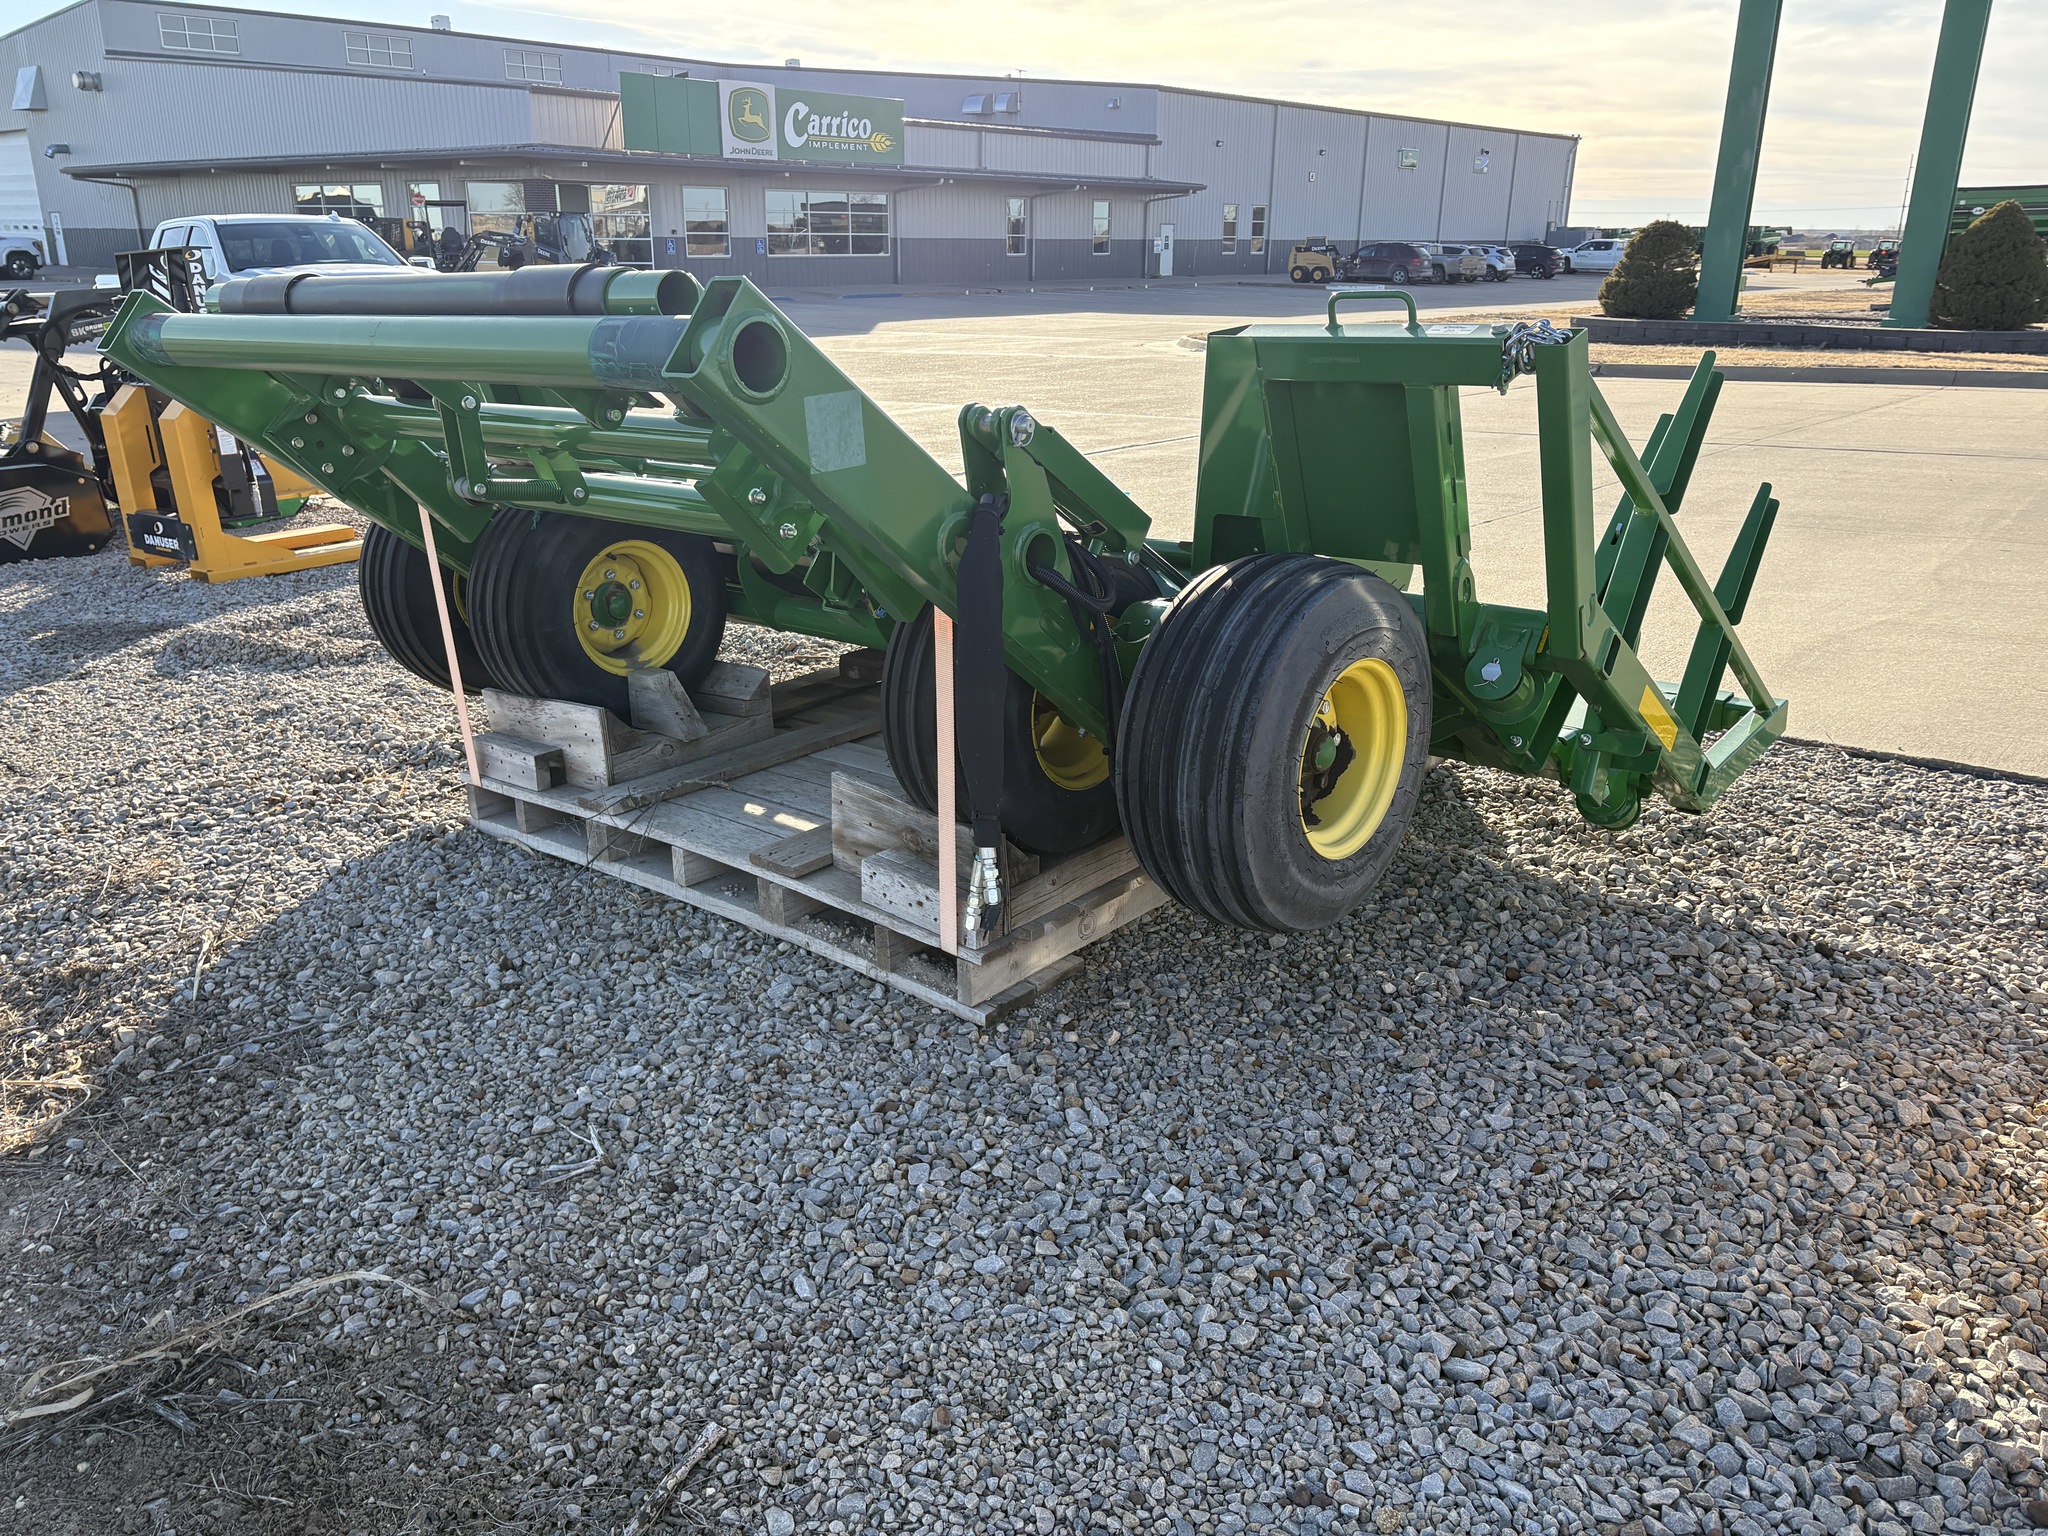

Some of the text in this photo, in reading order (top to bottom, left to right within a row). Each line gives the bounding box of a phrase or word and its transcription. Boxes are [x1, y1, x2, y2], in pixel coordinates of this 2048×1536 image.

[784, 101, 872, 148] Carrico
[808, 140, 869, 151] IMPLEMENT
[729, 146, 774, 157] JOHN DEERE
[480, 238, 498, 247] DEERE
[537, 247, 551, 258] DEERE
[143, 533, 180, 550] DANUSER
